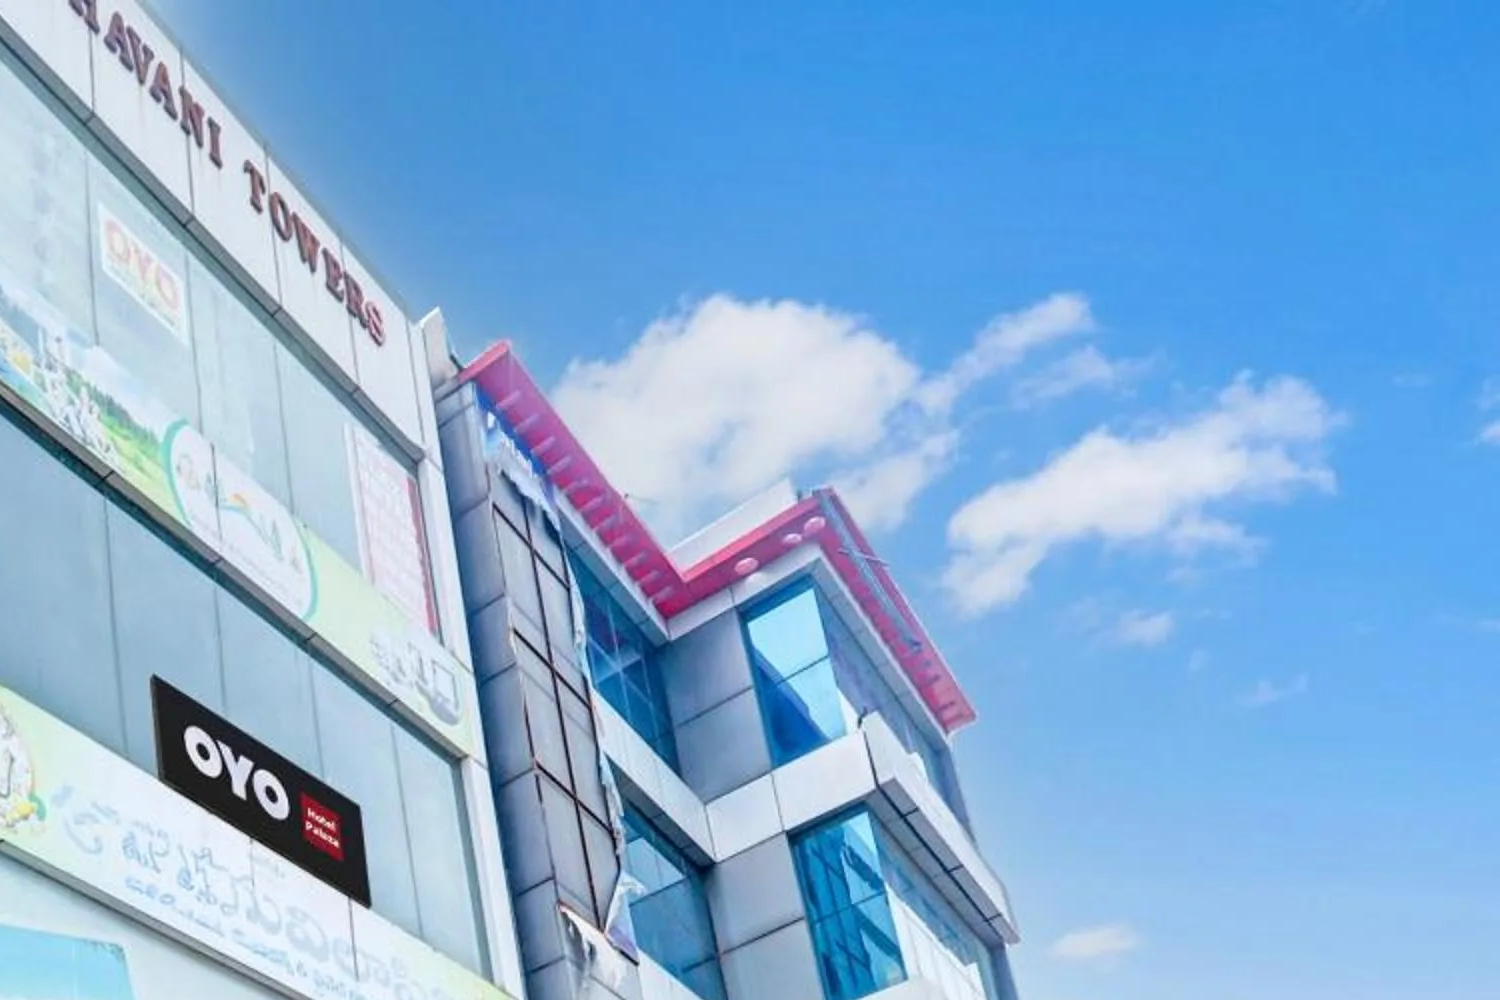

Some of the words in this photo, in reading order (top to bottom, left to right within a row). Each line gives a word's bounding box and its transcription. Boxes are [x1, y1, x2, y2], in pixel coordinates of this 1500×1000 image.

[104, 219, 181, 311] OYO
[243, 159, 386, 347] TOWERS
[183, 725, 291, 821] OYO
[307, 807, 336, 832] Hotel
